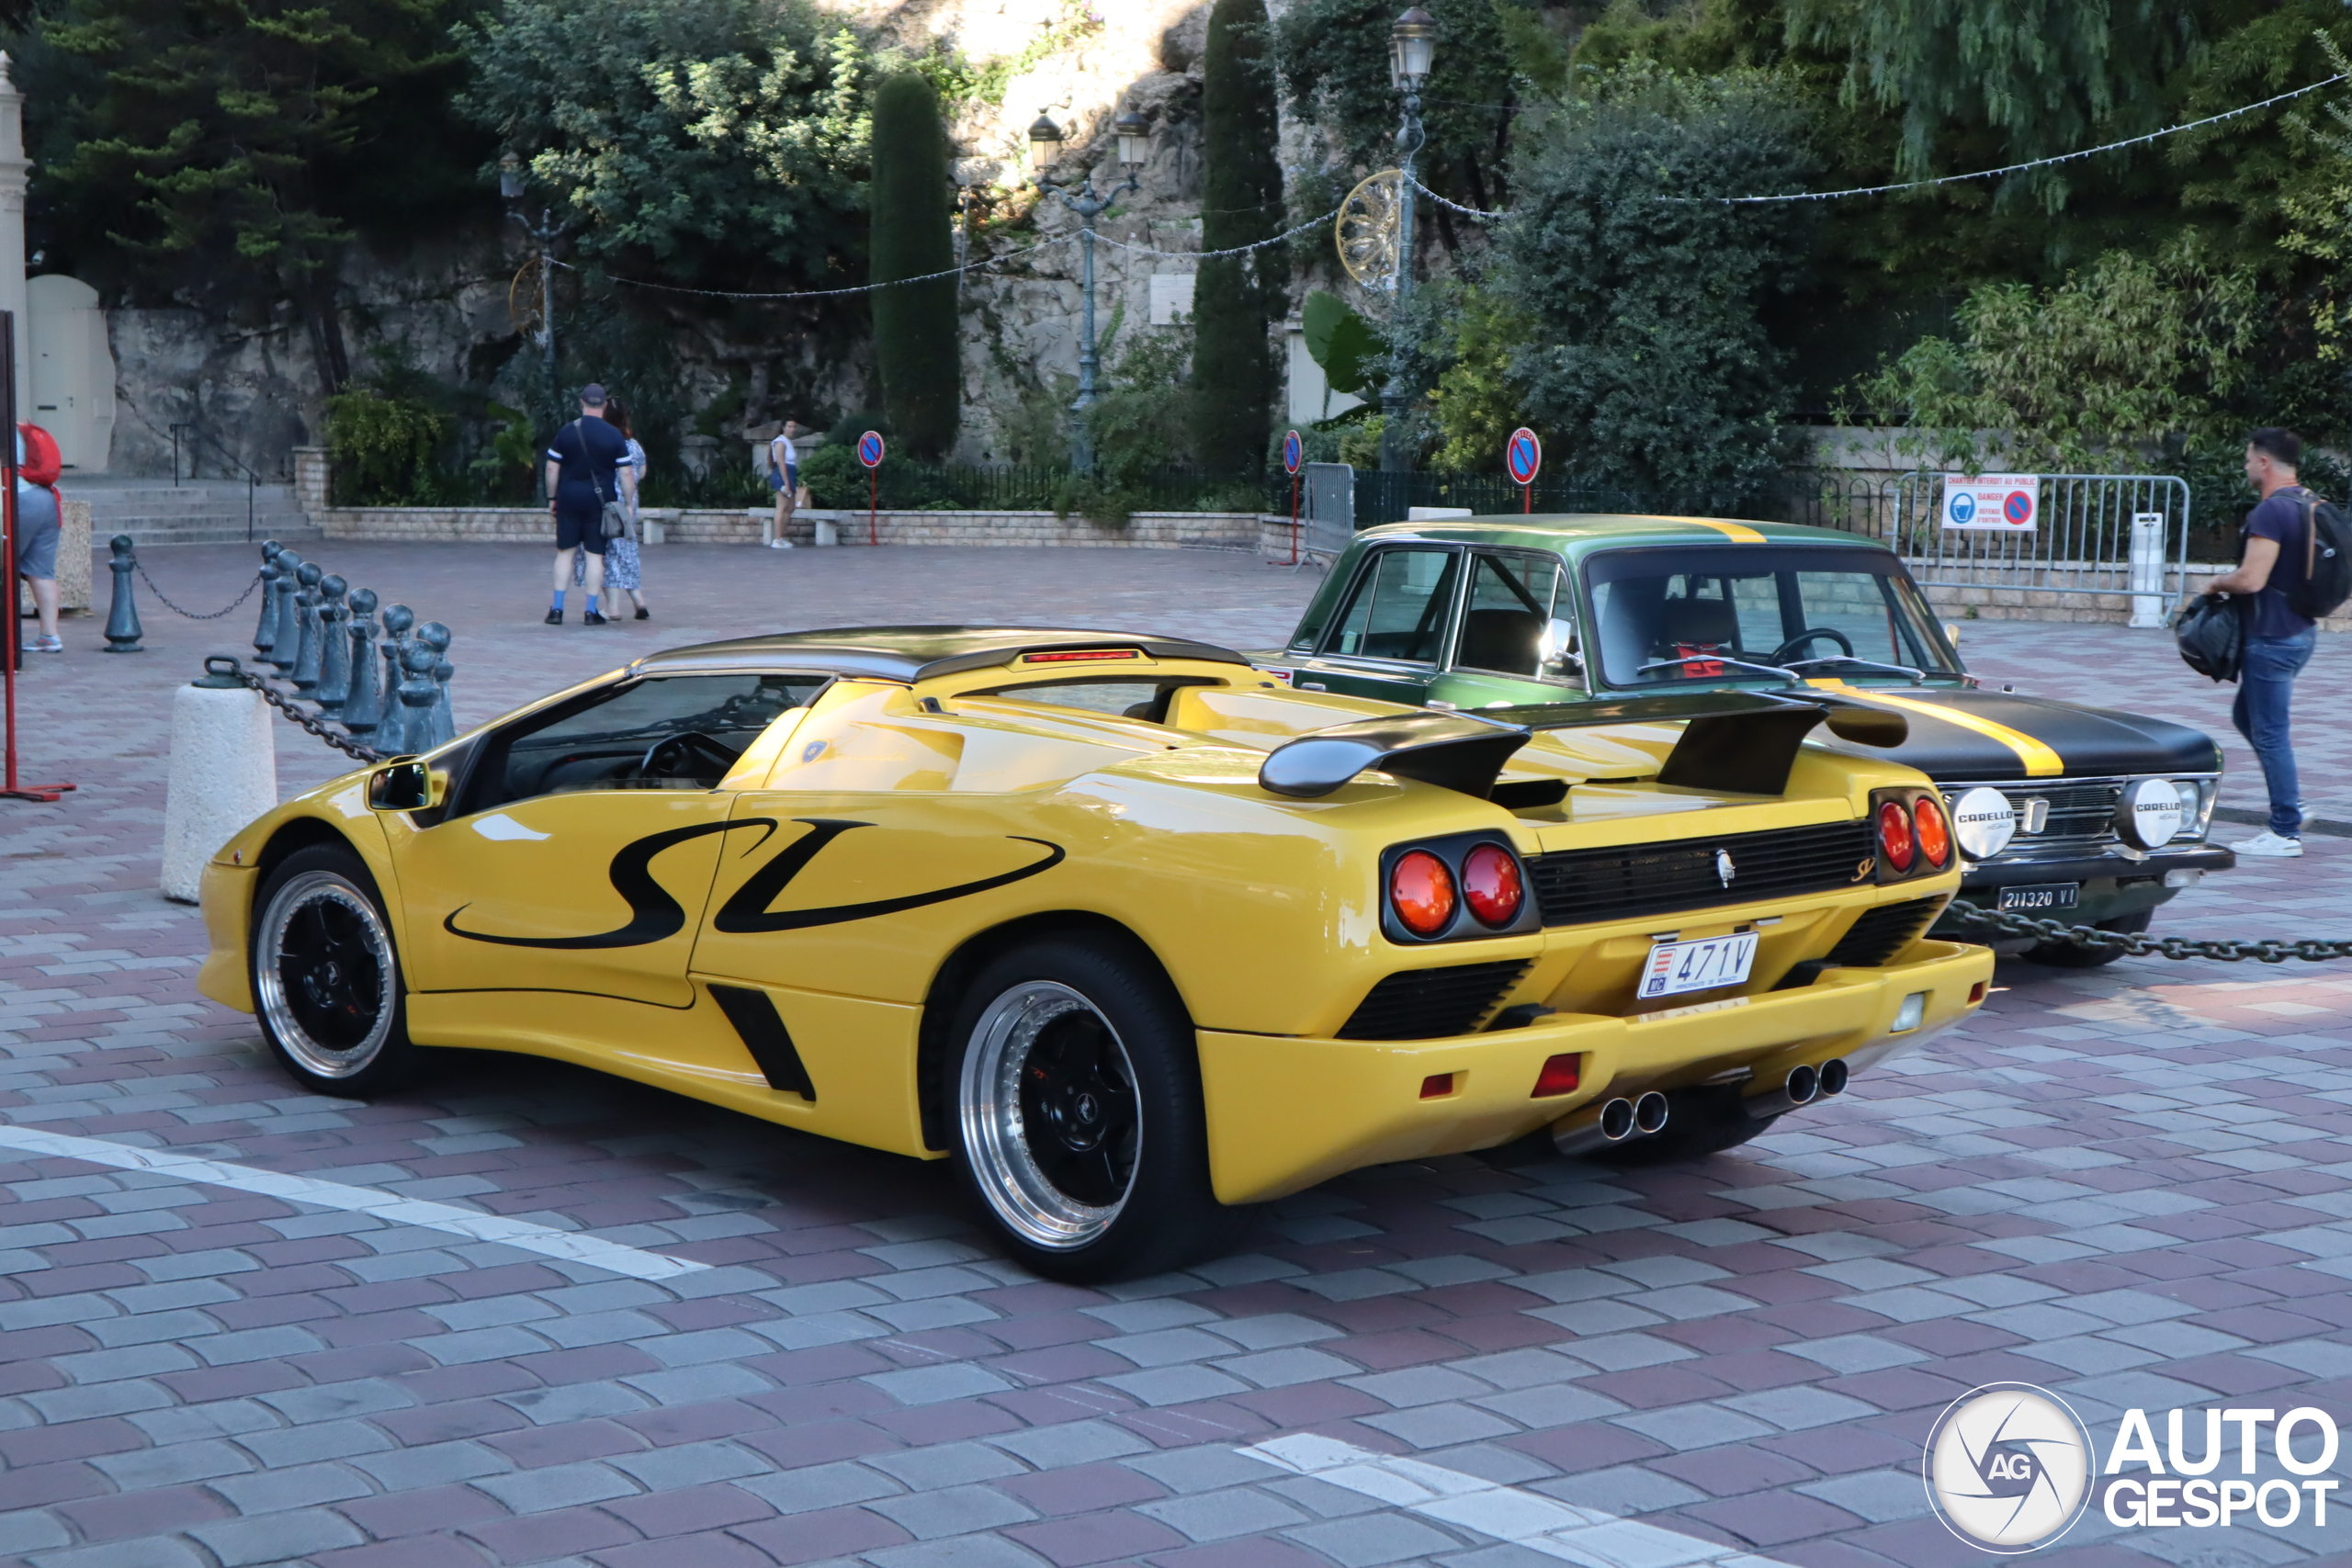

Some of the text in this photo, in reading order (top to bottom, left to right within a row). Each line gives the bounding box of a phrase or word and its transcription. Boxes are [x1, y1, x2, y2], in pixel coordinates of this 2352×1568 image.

[1948, 476, 2037, 486] CHANTIER INTERDIT AU PUBLIC
[1977, 492, 2004, 502] DANGER
[2136, 802, 2181, 813] CARELLO
[1958, 810, 2013, 823] CARELLO
[2004, 891, 2053, 908] 211320
[1677, 939, 1752, 982] 471V
[1649, 978, 1665, 991] MC
